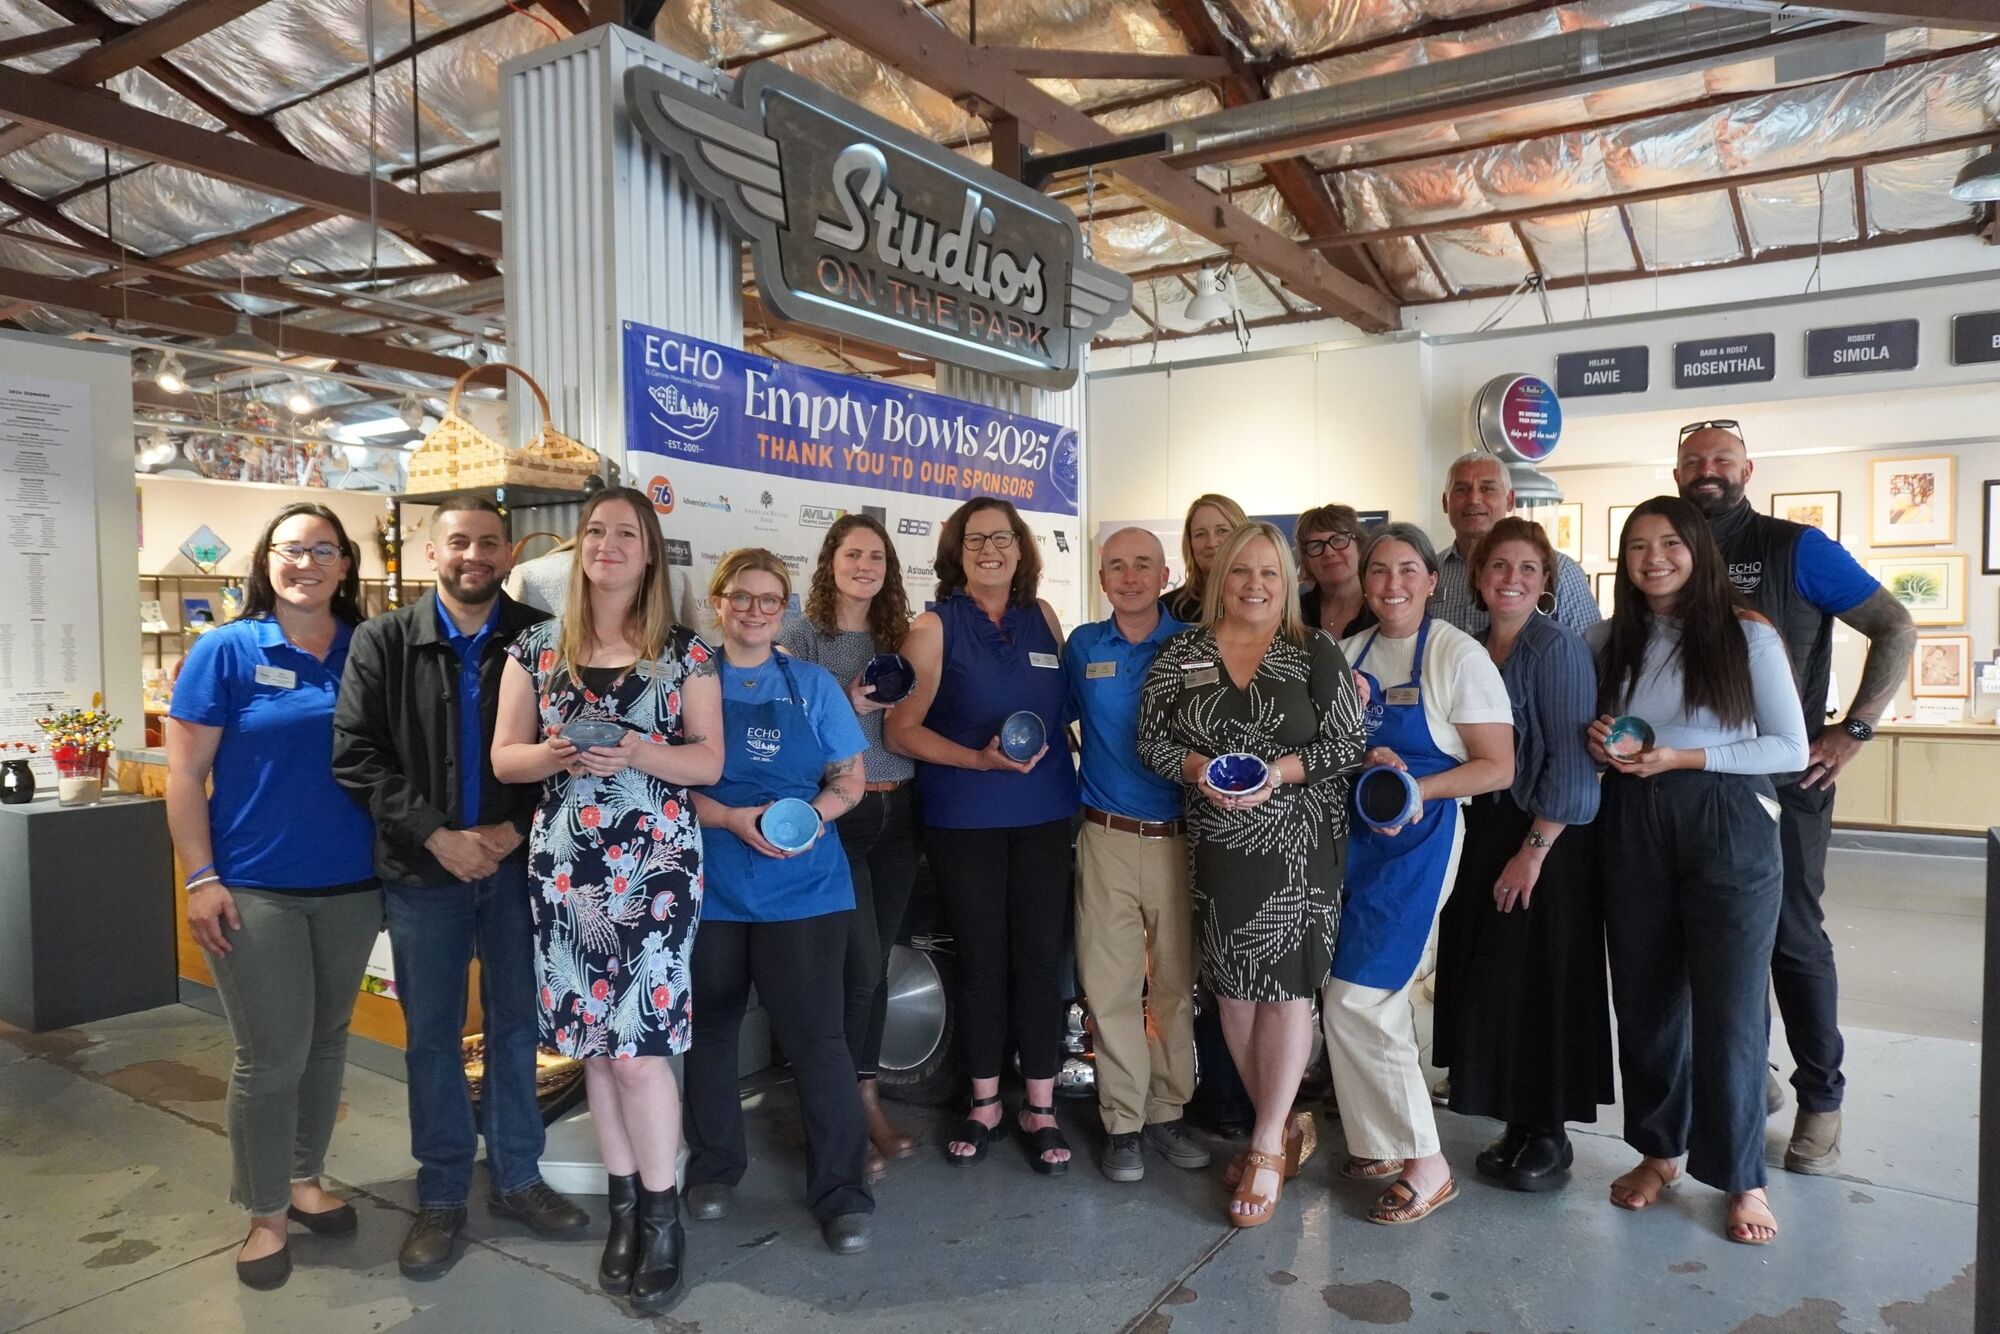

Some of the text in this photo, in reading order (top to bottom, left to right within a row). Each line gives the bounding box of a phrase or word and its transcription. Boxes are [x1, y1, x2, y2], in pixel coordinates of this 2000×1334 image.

[814, 142, 1046, 315] Studios
[816, 254, 1052, 358] ON THE PARK
[1847, 333, 1876, 343] ROBERT
[645, 334, 722, 380] ECHO
[1700, 345, 1748, 357] BARB & ROSEY
[1833, 346, 1890, 364] SIMOLA
[1588, 358, 1609, 367] HELEN
[1683, 357, 1765, 377] ROSENTHAL
[1584, 370, 1621, 385] DAVIE
[745, 368, 1050, 471] Empty Bowls 2025
[757, 432, 1035, 499] THANK YOU TO OUR SPONSORS
[652, 485, 671, 505] 76
[802, 508, 835, 521] AVILA
[1729, 561, 1762, 573] ECHO
[1366, 704, 1384, 715] CHO
[747, 727, 781, 739] ECHO
